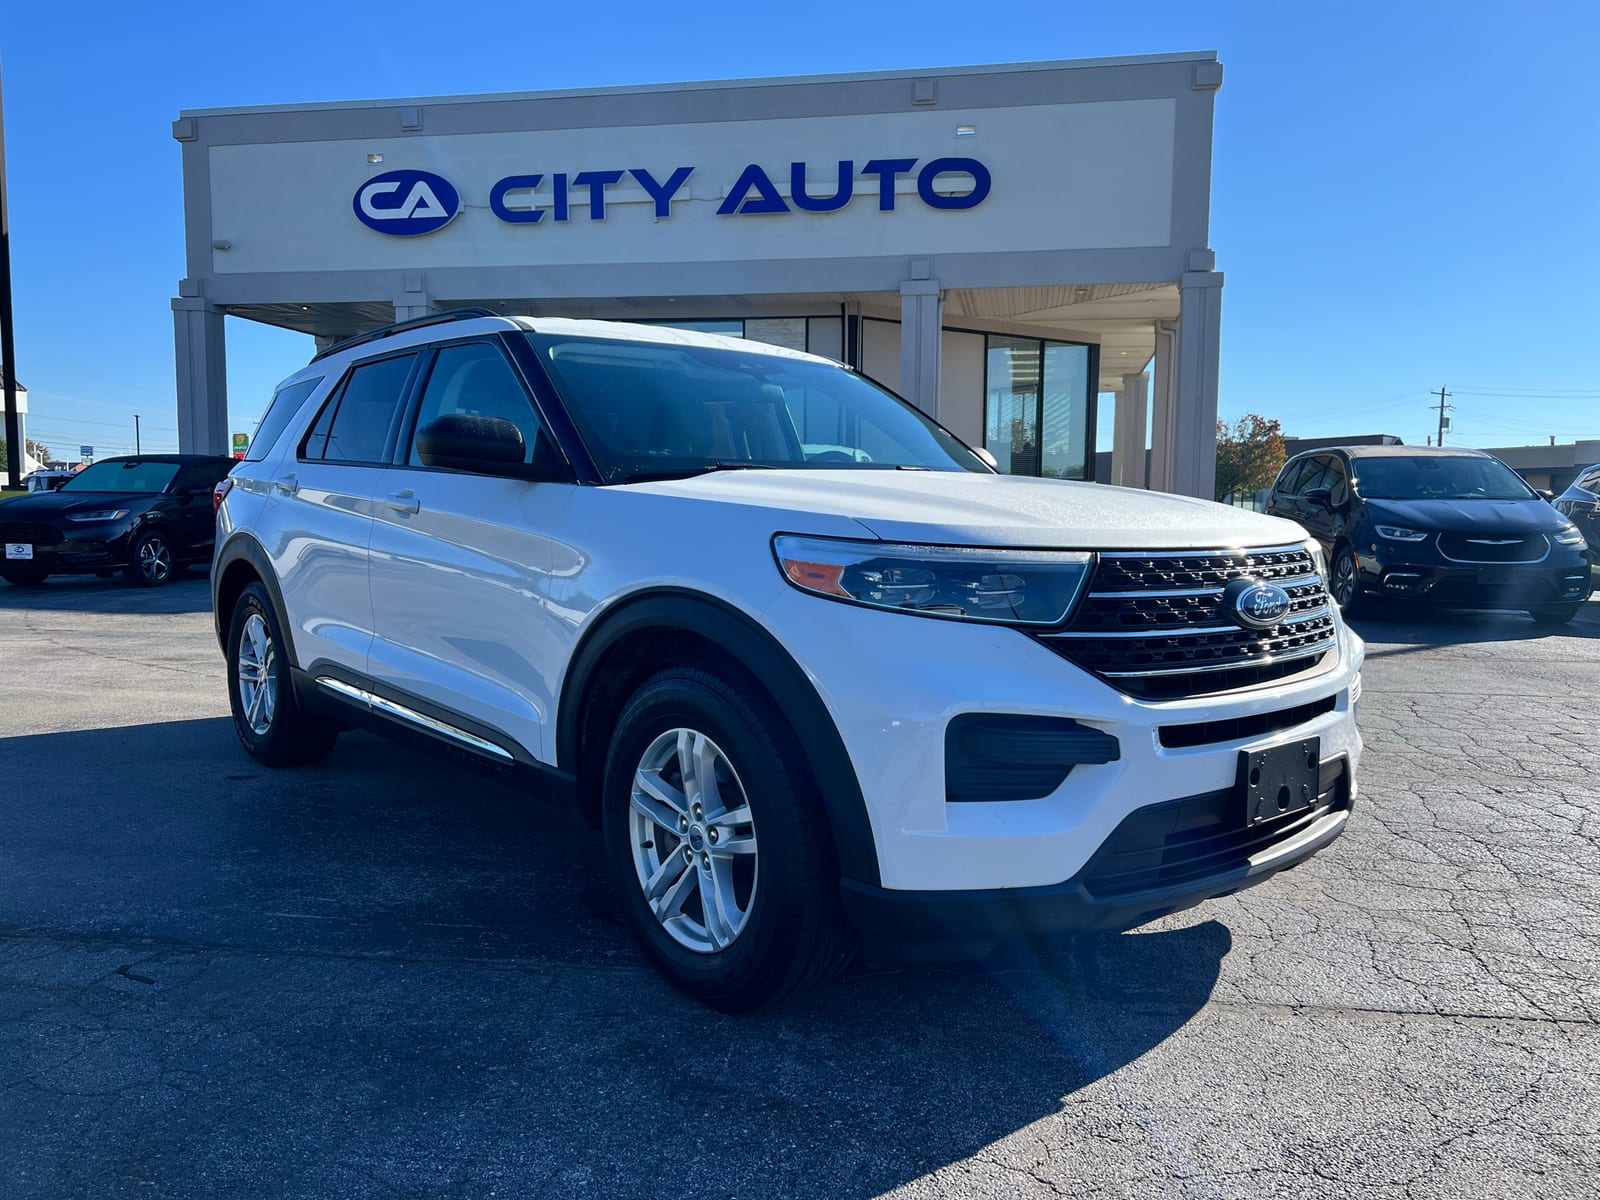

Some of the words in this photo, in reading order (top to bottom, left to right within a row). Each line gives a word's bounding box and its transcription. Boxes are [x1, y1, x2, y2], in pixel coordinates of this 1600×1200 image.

[360, 180, 449, 220] CA
[489, 166, 696, 224] CITY
[715, 157, 992, 216] AUTO
[1254, 592, 1282, 616] Ford
